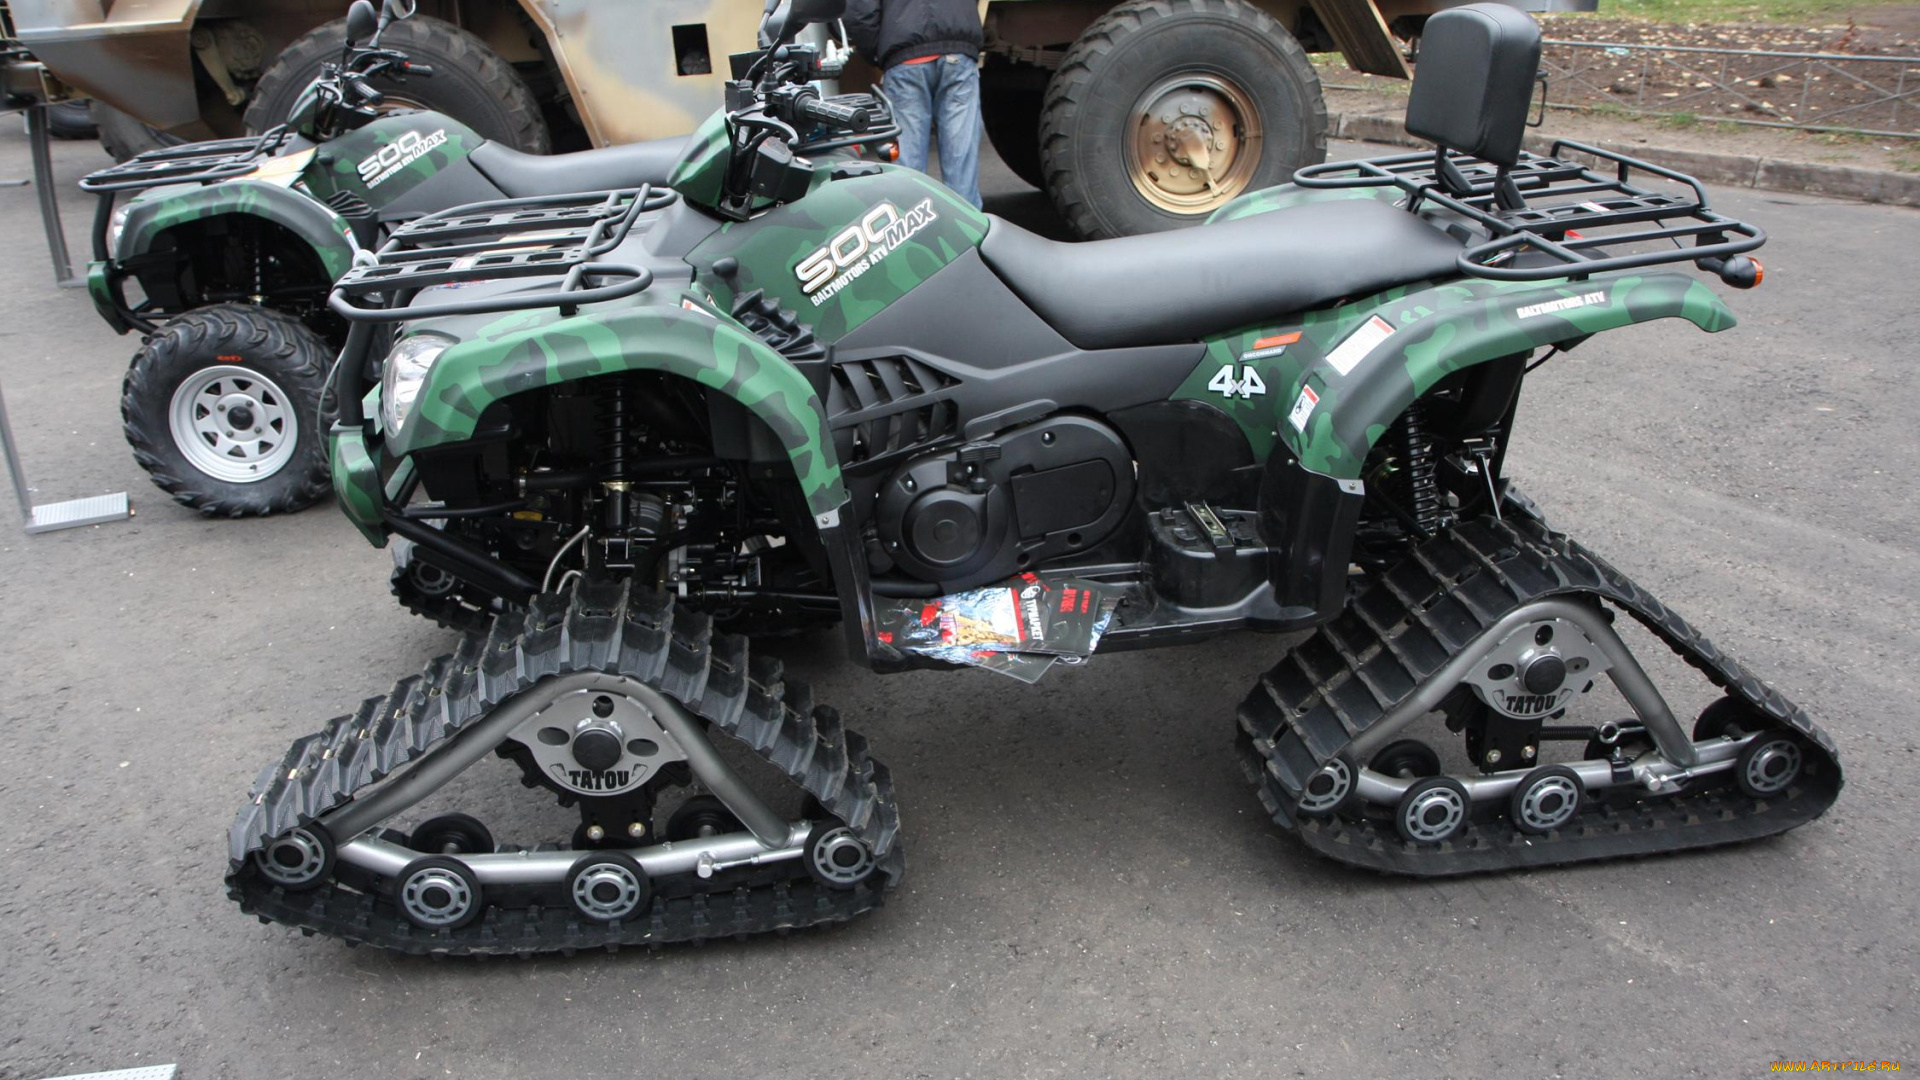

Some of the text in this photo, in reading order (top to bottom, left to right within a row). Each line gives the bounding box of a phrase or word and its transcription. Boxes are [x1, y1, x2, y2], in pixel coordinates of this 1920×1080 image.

[357, 131, 421, 182] 500
[412, 129, 447, 159] MAX
[366, 153, 415, 189] BALTMOTORS ATV
[884, 198, 937, 250] MAX
[795, 203, 899, 294] 500
[810, 245, 889, 307] BALTMOTORS ATV
[1516, 291, 1606, 319] BALTMOTORS ATV
[1506, 695, 1557, 714] TATOU
[568, 770, 630, 790] TATOU
